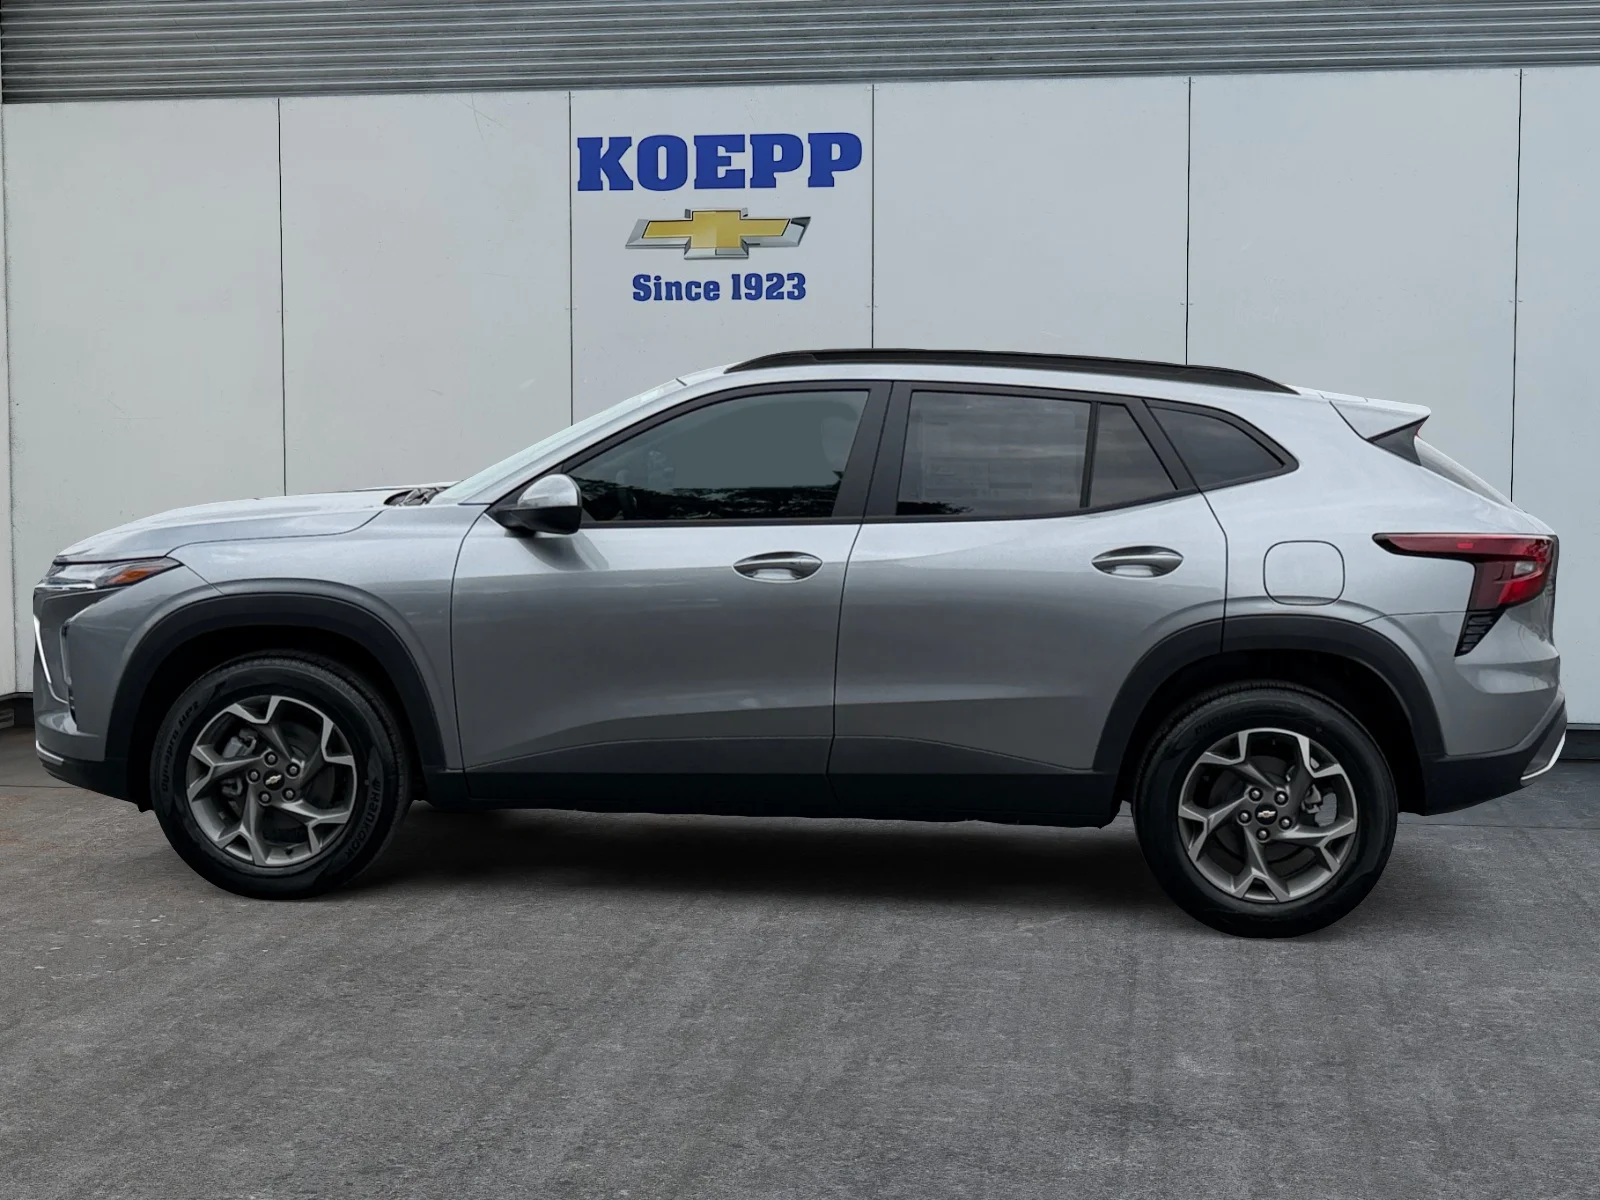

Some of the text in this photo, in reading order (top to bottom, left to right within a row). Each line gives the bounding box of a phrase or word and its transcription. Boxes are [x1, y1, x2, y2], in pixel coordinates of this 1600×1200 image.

[577, 132, 862, 191] KOEPP
[632, 272, 806, 301] Since 1923
